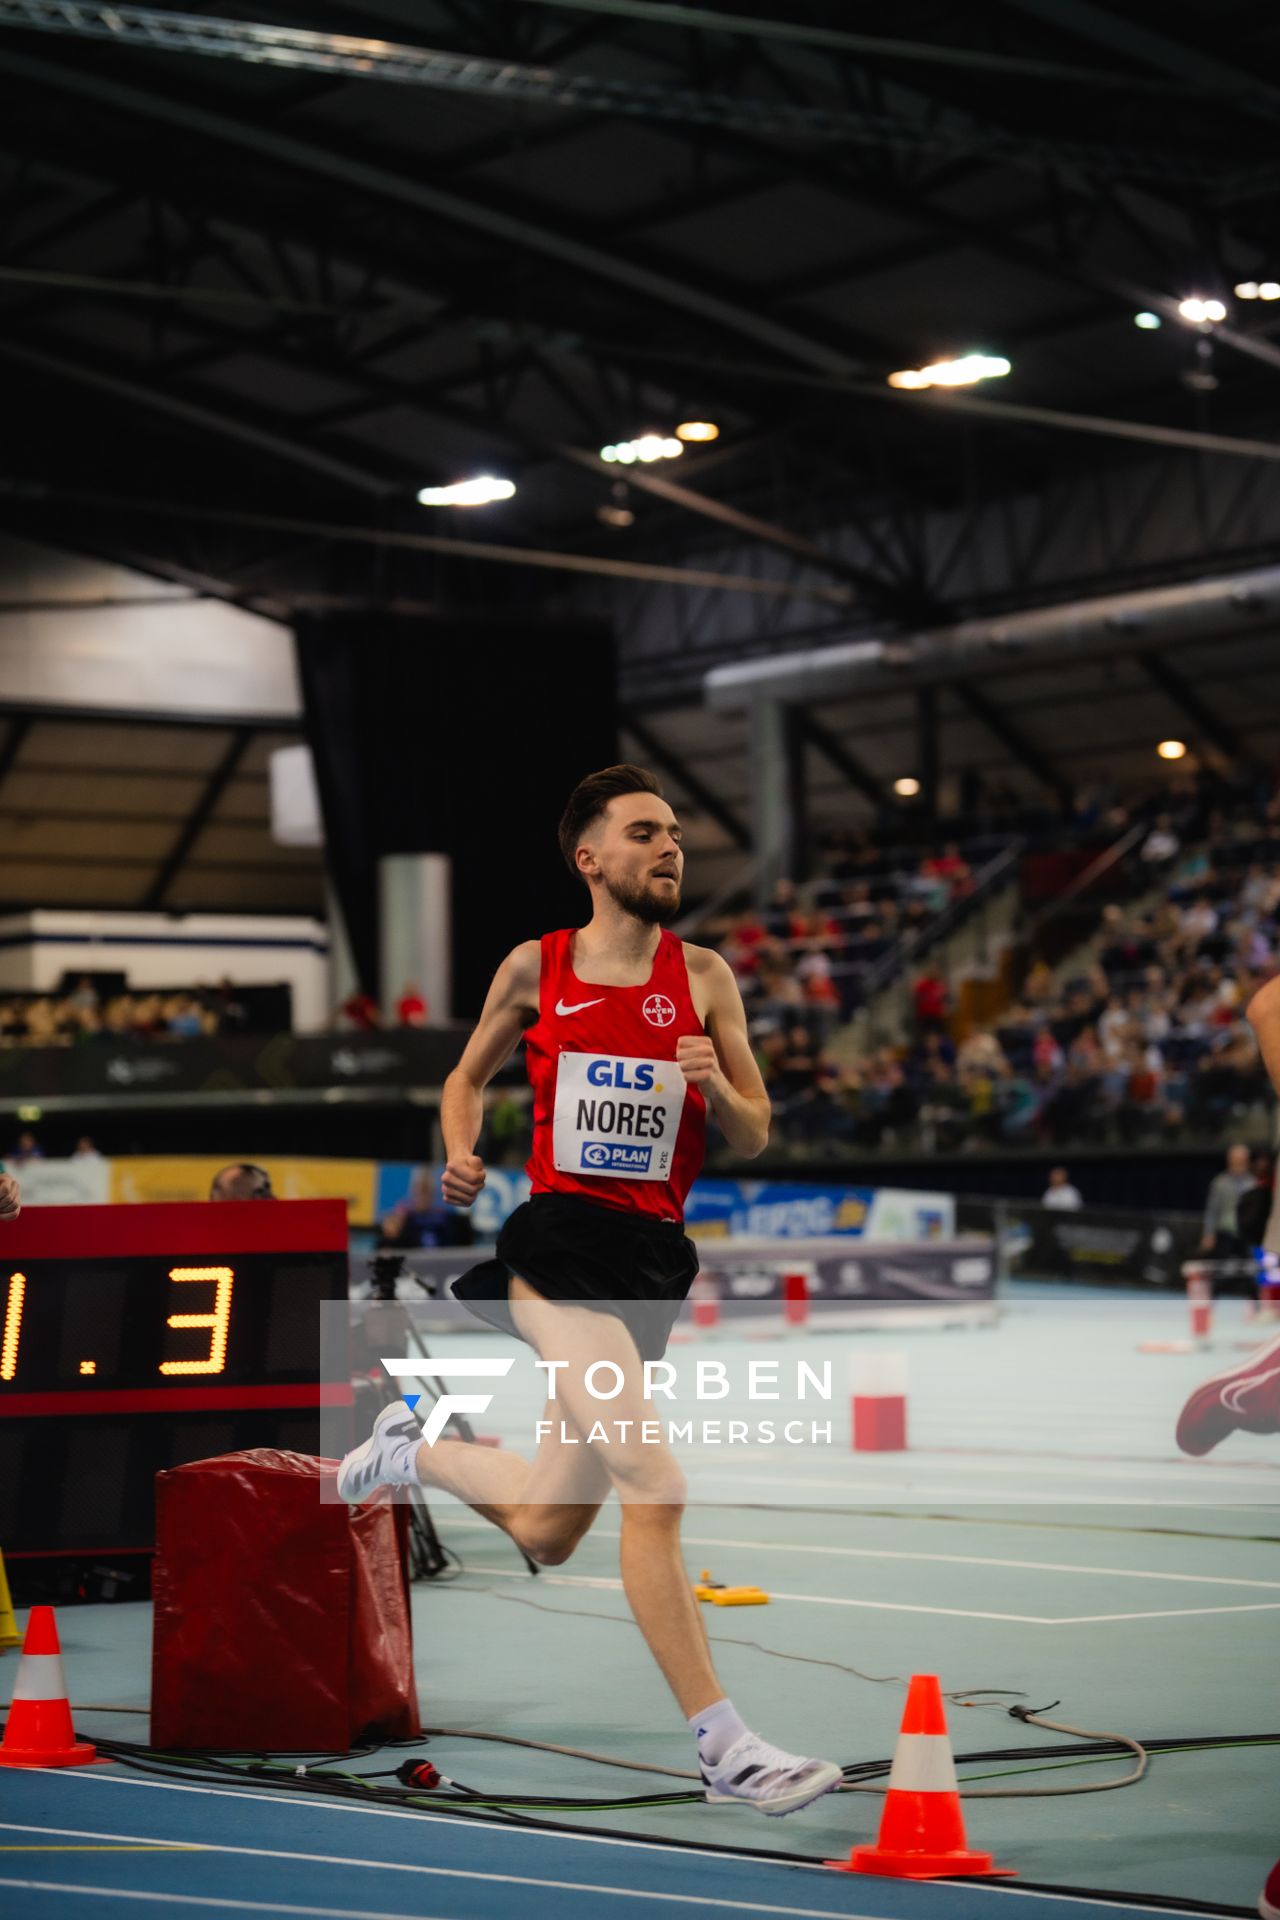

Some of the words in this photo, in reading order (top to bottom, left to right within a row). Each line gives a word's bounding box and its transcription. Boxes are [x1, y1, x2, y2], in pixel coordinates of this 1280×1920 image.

[576, 1099, 667, 1139] NORES
[612, 1148, 650, 1163] PLAN
[659, 1151, 668, 1169] 324
[611, 1161, 647, 1170] INTERNATIONAL
